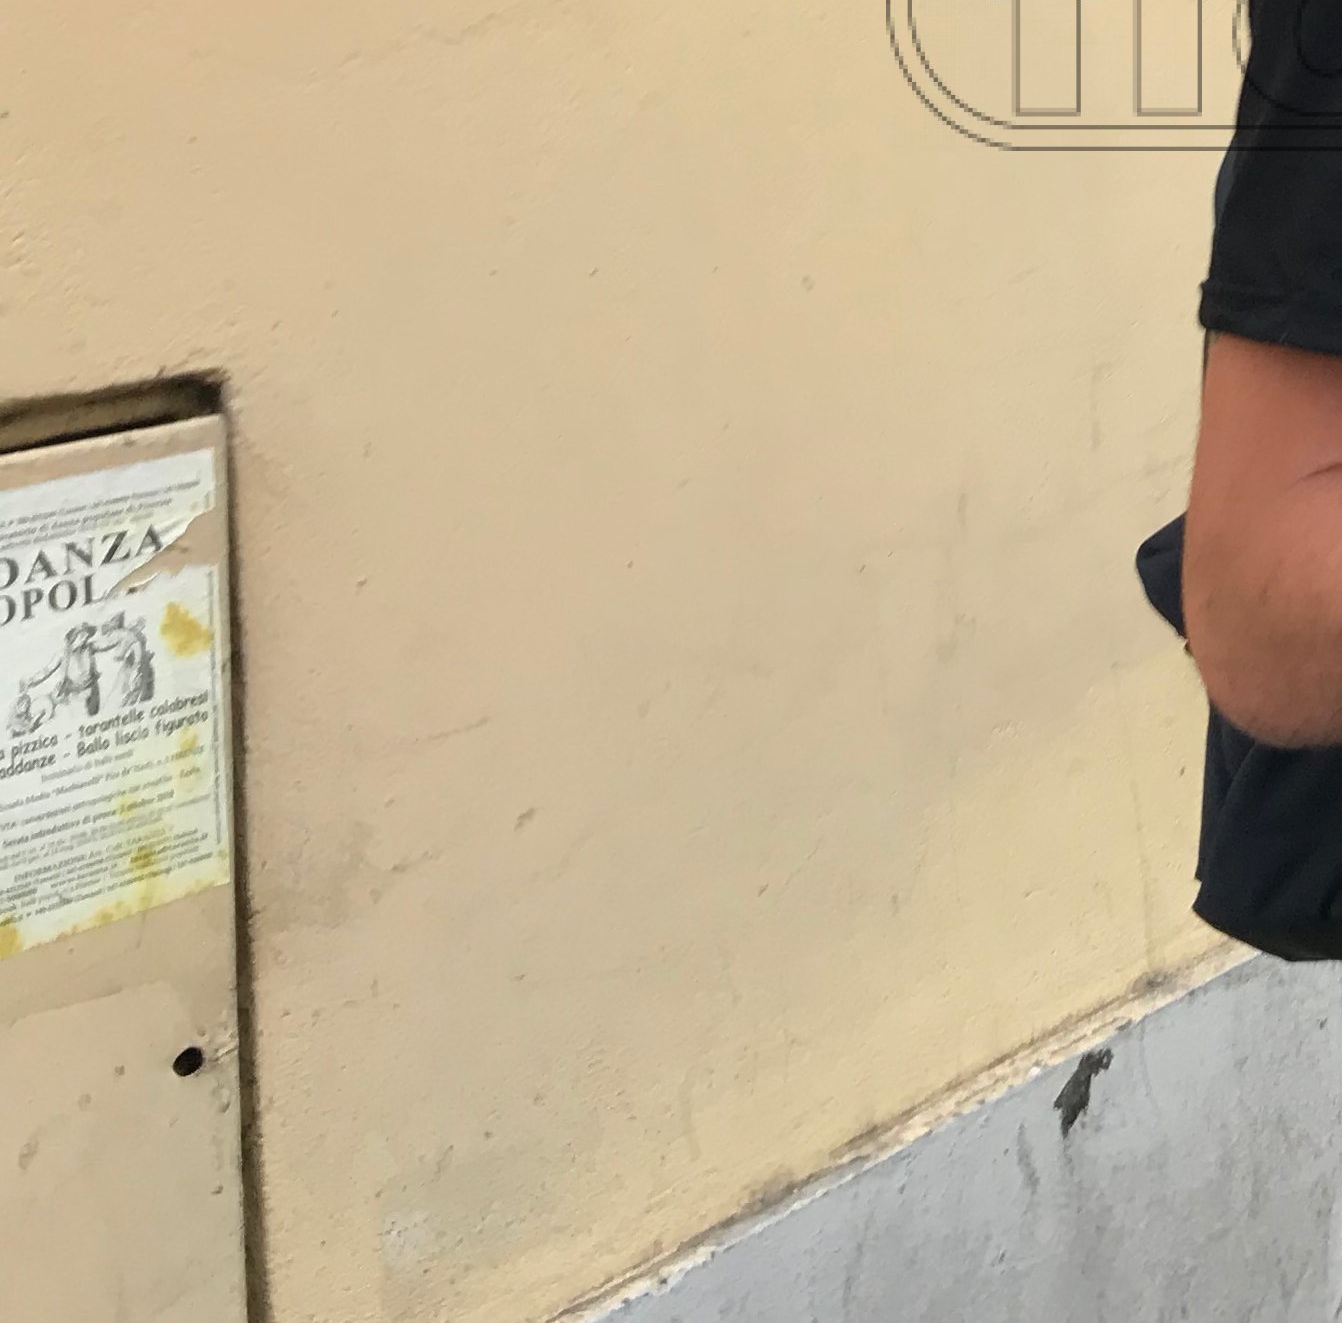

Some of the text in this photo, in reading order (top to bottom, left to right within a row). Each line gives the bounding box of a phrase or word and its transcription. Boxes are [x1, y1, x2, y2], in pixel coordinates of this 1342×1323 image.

[11, 734, 58, 766] pizzica
[78, 709, 145, 738] tarantelle
[77, 735, 110, 758] Ballo
